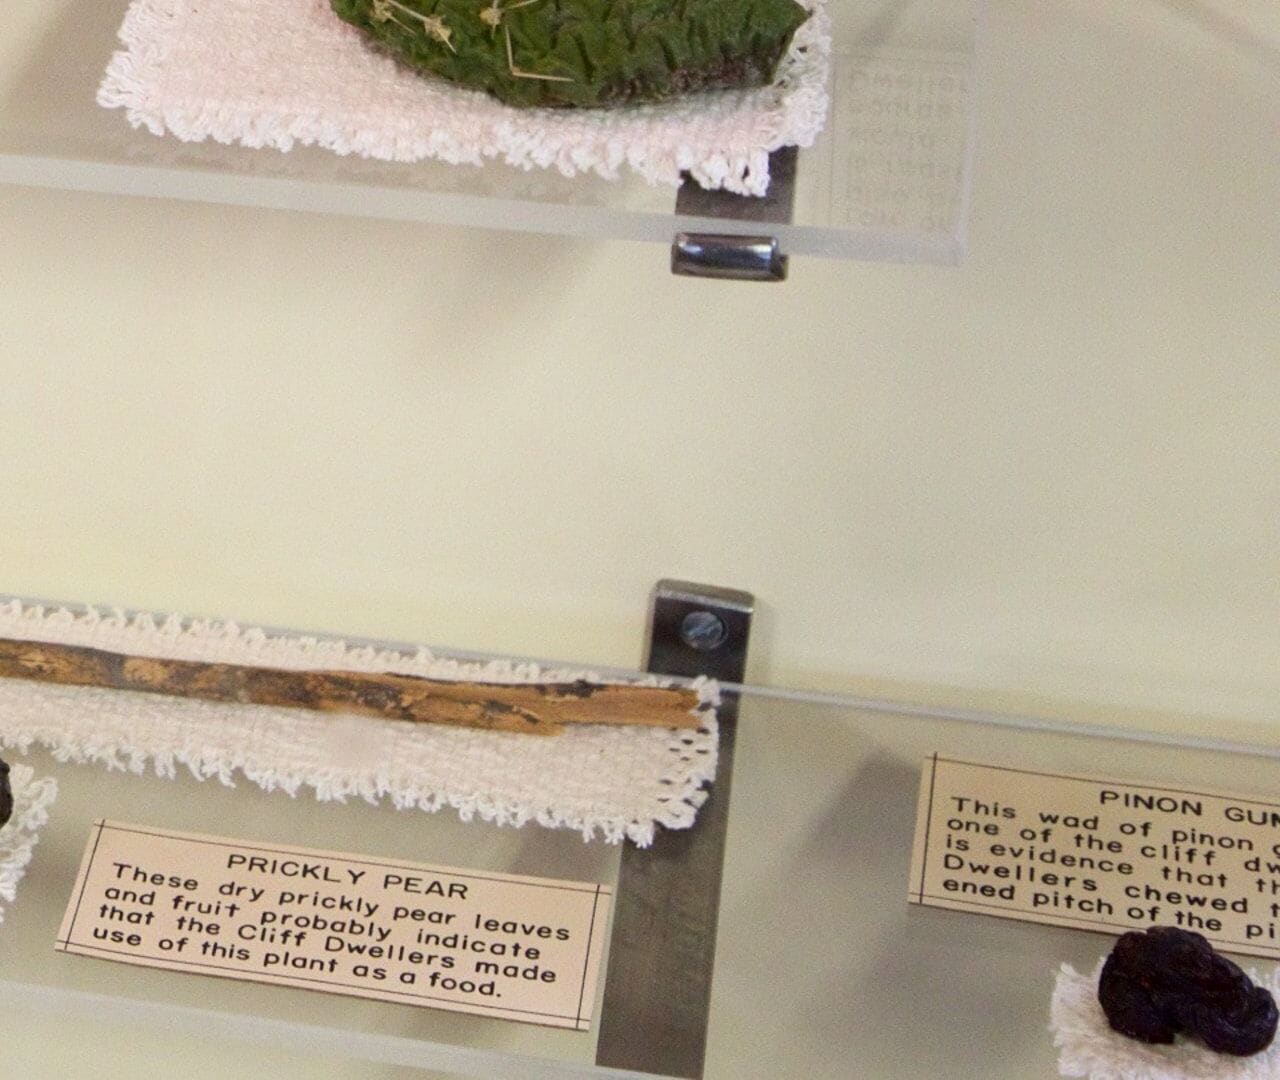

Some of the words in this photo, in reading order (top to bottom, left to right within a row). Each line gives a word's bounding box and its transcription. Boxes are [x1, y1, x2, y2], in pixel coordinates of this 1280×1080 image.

[950, 796, 1016, 820] This
[1038, 812, 1099, 831] wad
[1119, 821, 1151, 838] of
[1171, 828, 1254, 851] pinon
[1099, 790, 1203, 817] PINON
[946, 818, 1000, 836] one
[1019, 828, 1052, 843] of
[1074, 833, 1123, 854] the
[1140, 844, 1215, 866] cliff
[946, 833, 970, 852] is
[989, 844, 1133, 876] evidence
[1161, 866, 1228, 889] that
[112, 861, 199, 891] These
[218, 881, 265, 903] dry
[278, 891, 379, 918] prickly
[392, 906, 456, 925] pear
[474, 913, 570, 942] leaves
[226, 853, 366, 886] PRICKLY
[382, 874, 469, 900] PEAR
[99, 903, 155, 926] that
[176, 916, 221, 936] the
[237, 924, 307, 947] Cliff
[324, 935, 455, 969] Dwellers
[474, 961, 557, 984] made
[104, 887, 156, 906] and
[172, 894, 241, 918] fruit
[260, 911, 392, 943] probably
[416, 928, 541, 961] indicate
